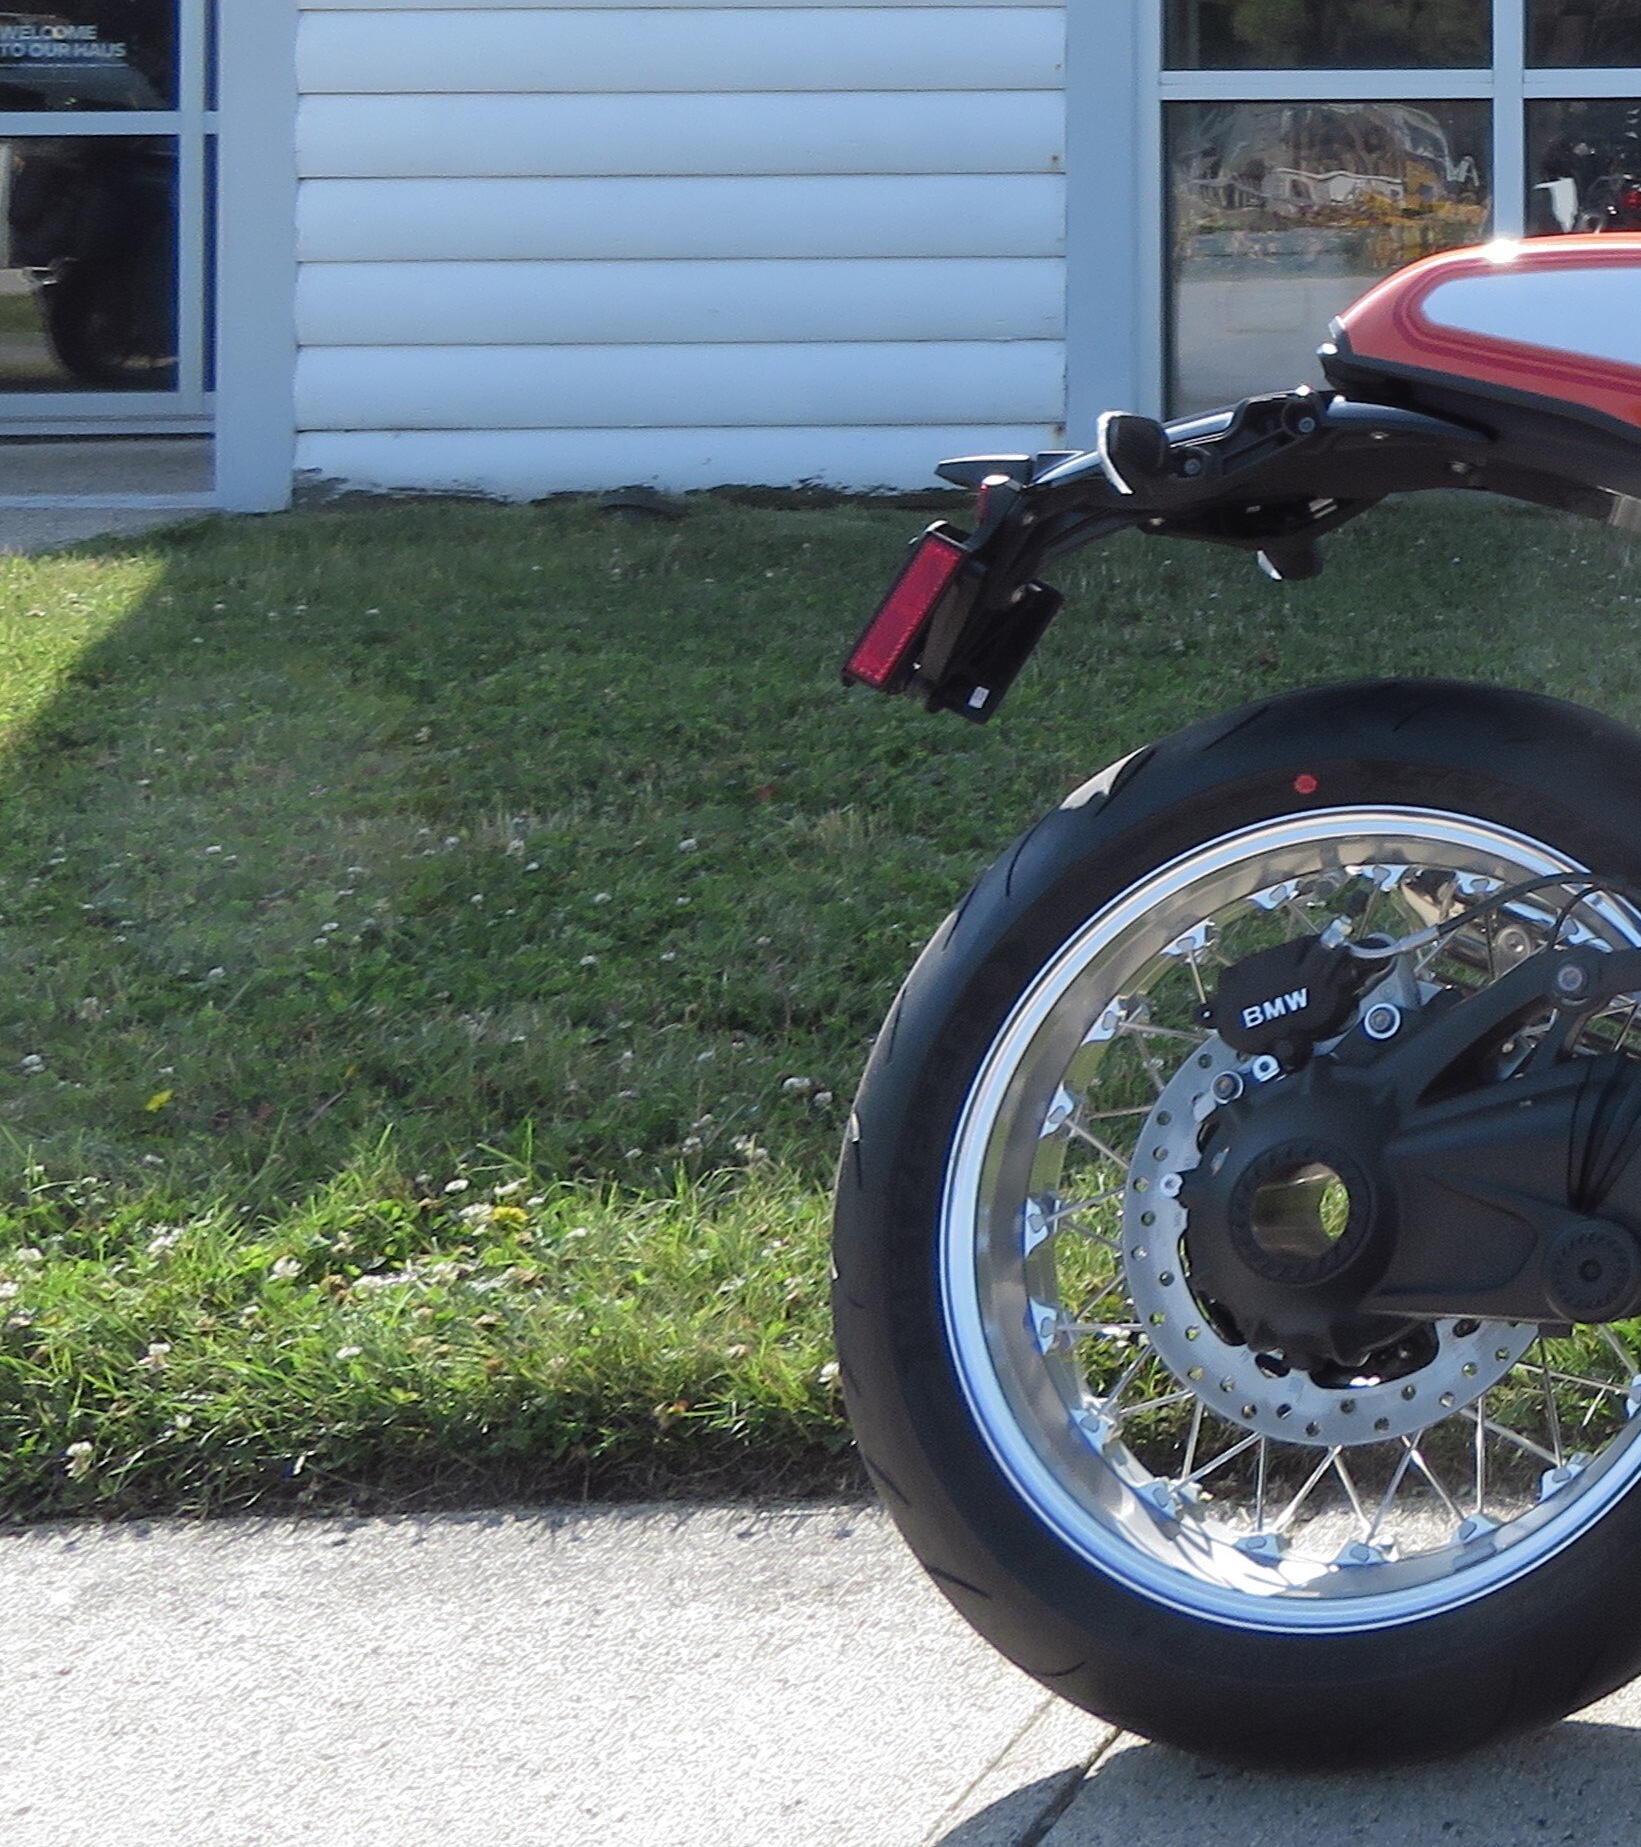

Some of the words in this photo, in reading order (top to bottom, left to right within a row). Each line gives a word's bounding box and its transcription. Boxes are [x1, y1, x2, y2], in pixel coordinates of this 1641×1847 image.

[0, 24, 98, 41] WELCOME
[0, 42, 26, 57] TO
[28, 42, 72, 57] OUR
[73, 42, 127, 57] HAUS
[1241, 987, 1309, 1030] BMW
